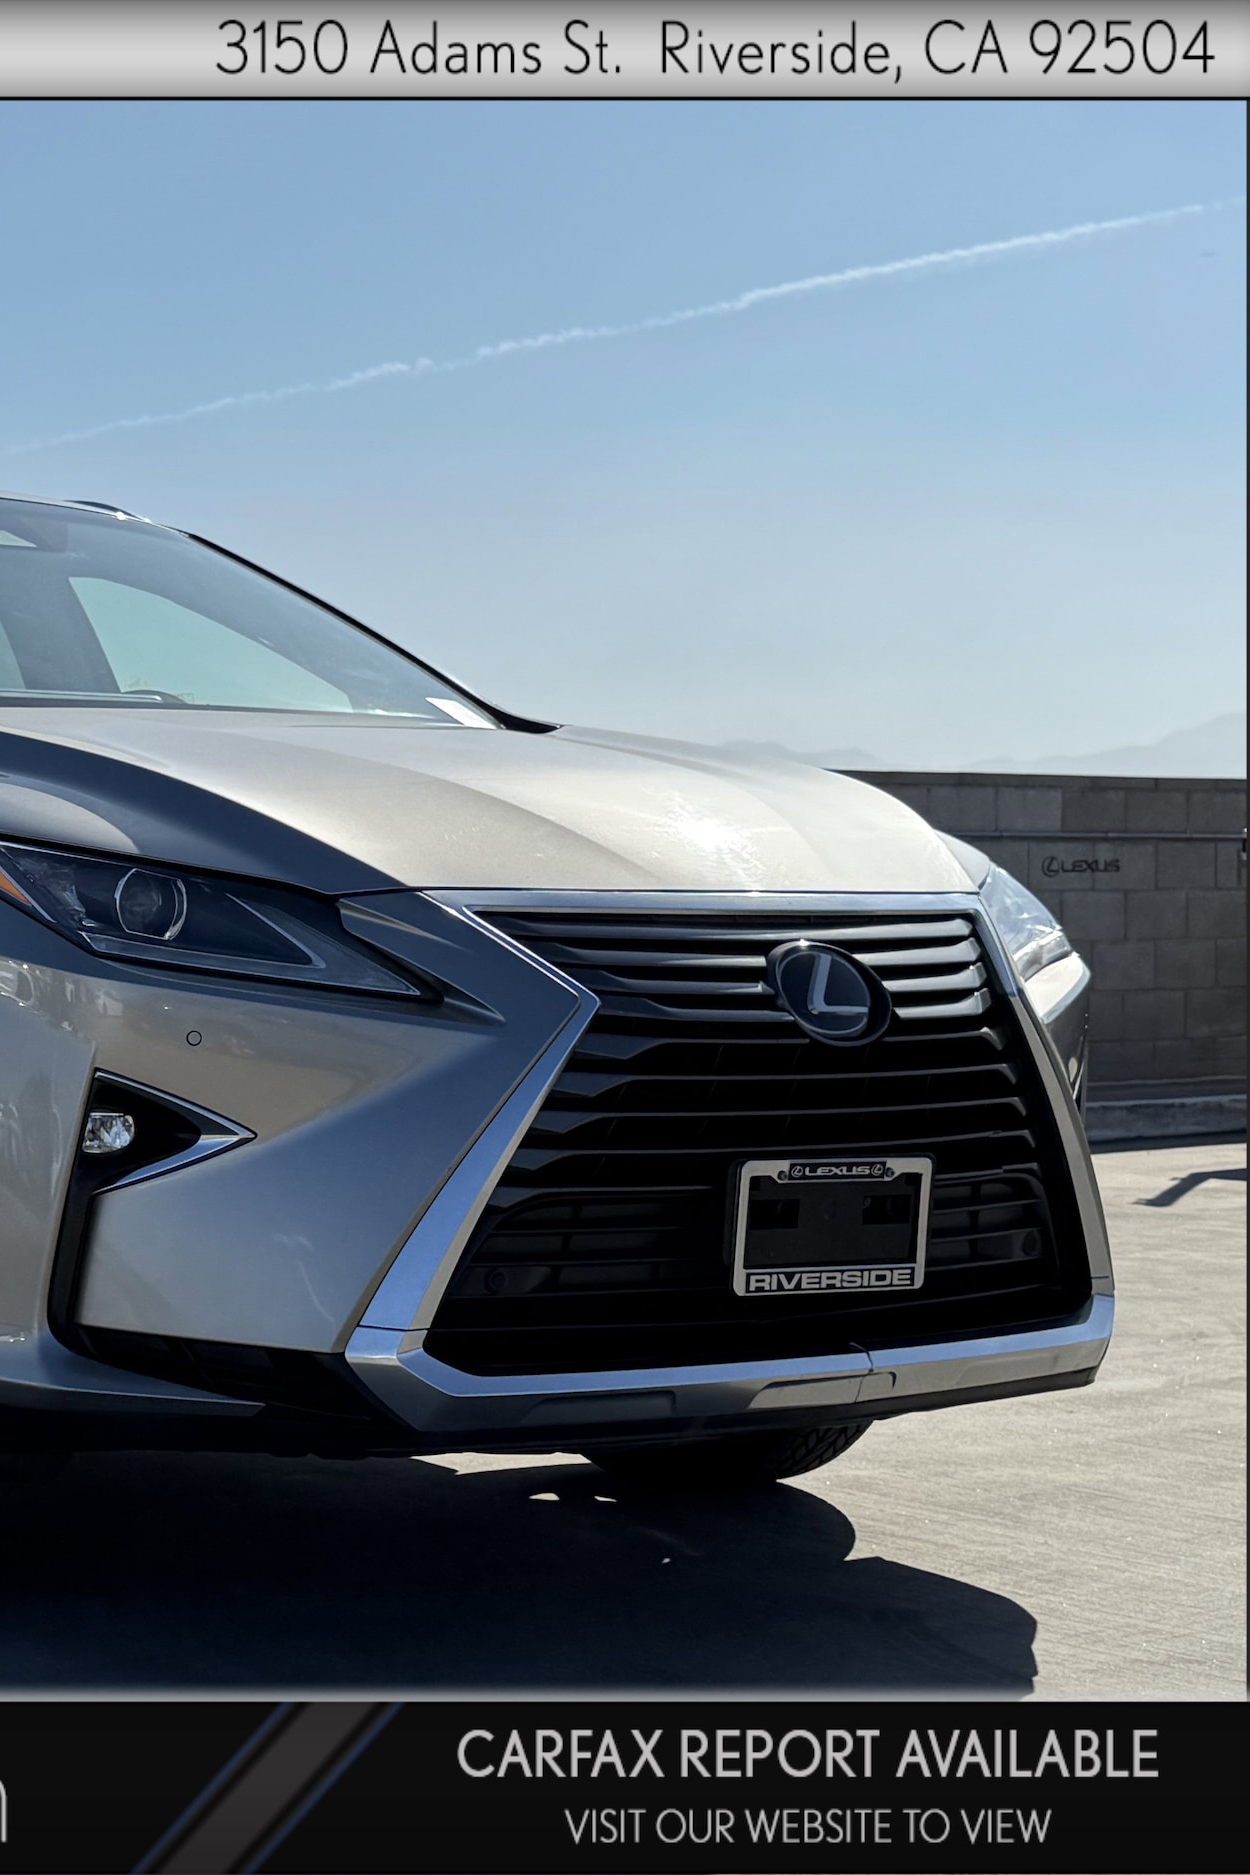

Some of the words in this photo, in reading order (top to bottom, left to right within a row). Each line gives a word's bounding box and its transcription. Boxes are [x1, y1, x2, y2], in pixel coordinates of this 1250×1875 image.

[1061, 858, 1121, 873] LEXUS
[804, 1164, 871, 1176] LEXUS
[748, 1268, 913, 1292] RIVERSIDE
